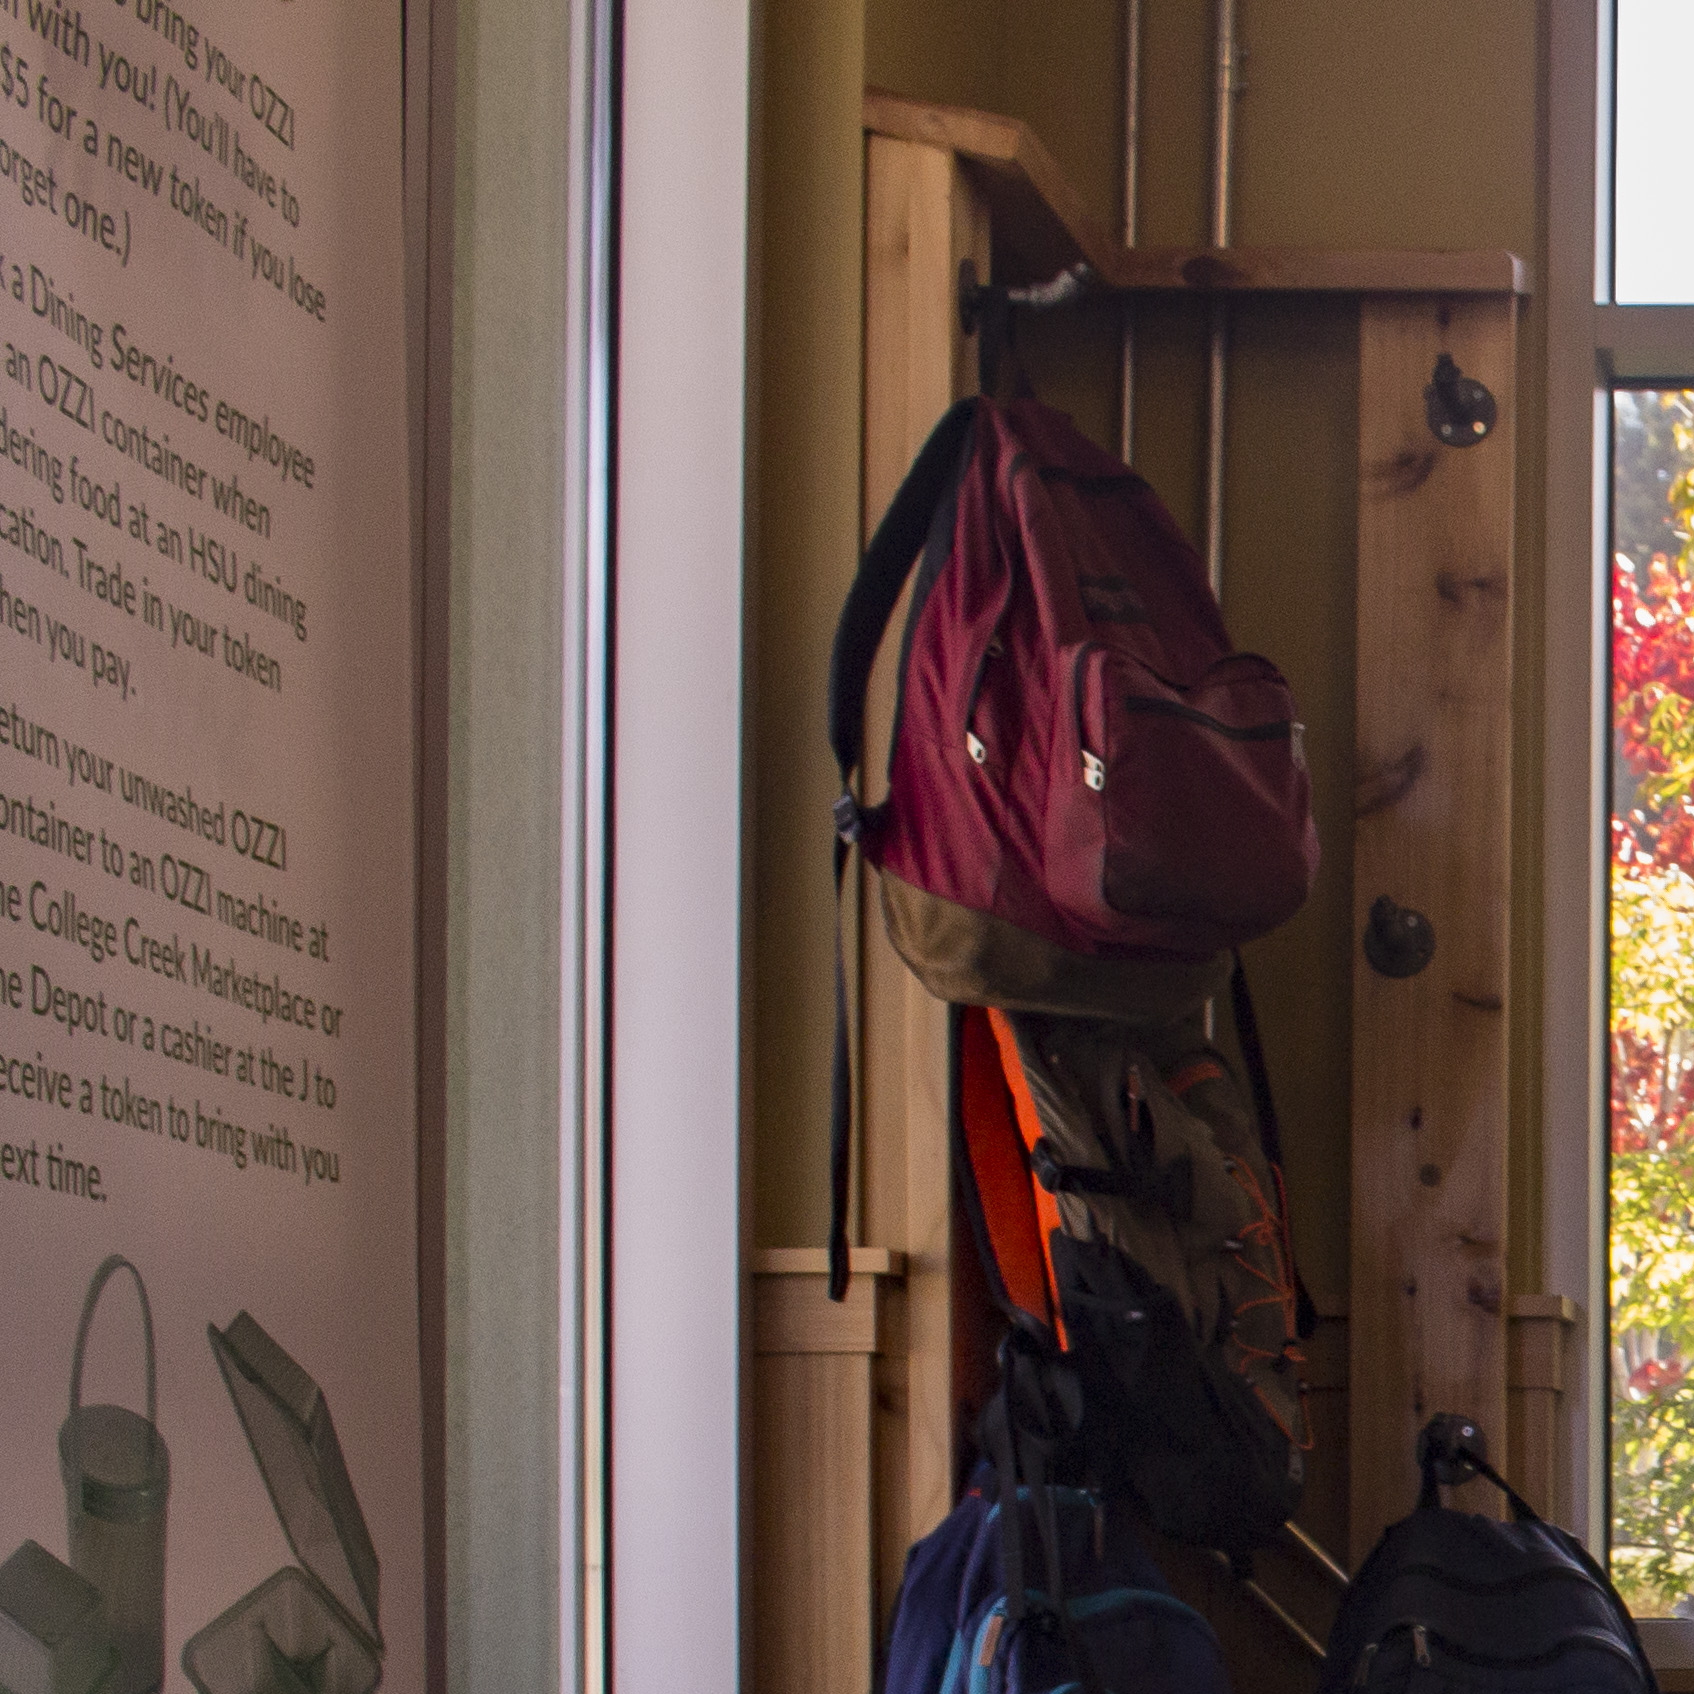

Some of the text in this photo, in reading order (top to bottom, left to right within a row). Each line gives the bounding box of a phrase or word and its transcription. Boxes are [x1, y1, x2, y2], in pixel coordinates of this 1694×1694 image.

[27, 0, 299, 228] with you! (You'll have to
[204, 37, 246, 102] your
[250, 73, 295, 150] OZZI
[37, 73, 77, 141] for
[83, 118, 98, 156] a
[107, 131, 163, 197] new
[169, 163, 228, 248] token
[233, 208, 248, 262] if
[250, 234, 284, 291] you
[288, 255, 327, 325] lose
[64, 191, 131, 268] one.)
[5, 340, 271, 541] an OZZI container when
[12, 263, 315, 490] a Dining Services employee
[68, 453, 122, 530] food
[128, 502, 151, 547] at
[156, 521, 183, 565] an
[188, 525, 238, 595] HSU
[243, 560, 308, 643] dining
[72, 536, 136, 617] Trade
[142, 575, 164, 632] in
[167, 602, 218, 658] your
[222, 623, 282, 693] token
[45, 613, 85, 669] you
[91, 642, 137, 701] pay.
[63, 737, 114, 795] your
[118, 766, 226, 847] unwashed
[230, 808, 287, 871] OZZI
[29, 879, 117, 964] College
[123, 915, 187, 985] Creek
[190, 941, 316, 1031] Marketplace
[320, 1001, 344, 1039] or
[99, 827, 124, 879] to
[128, 849, 155, 895] an
[159, 852, 212, 917] OZZI
[216, 889, 303, 953] machine
[308, 920, 329, 963] at
[30, 963, 108, 1038] Depot
[113, 1004, 137, 1046] or
[141, 1016, 155, 1052] a
[160, 1020, 232, 1077] cashier
[235, 1045, 256, 1087] at
[259, 1045, 295, 1099] the
[298, 1057, 308, 1101] J
[312, 1064, 337, 1110] to
[46, 1142, 107, 1202] time.
[79, 1078, 93, 1115] a
[100, 1073, 163, 1135] token
[167, 1096, 190, 1143] to
[194, 1099, 248, 1170] bring
[250, 1122, 297, 1174] with
[300, 1142, 340, 1186] you
